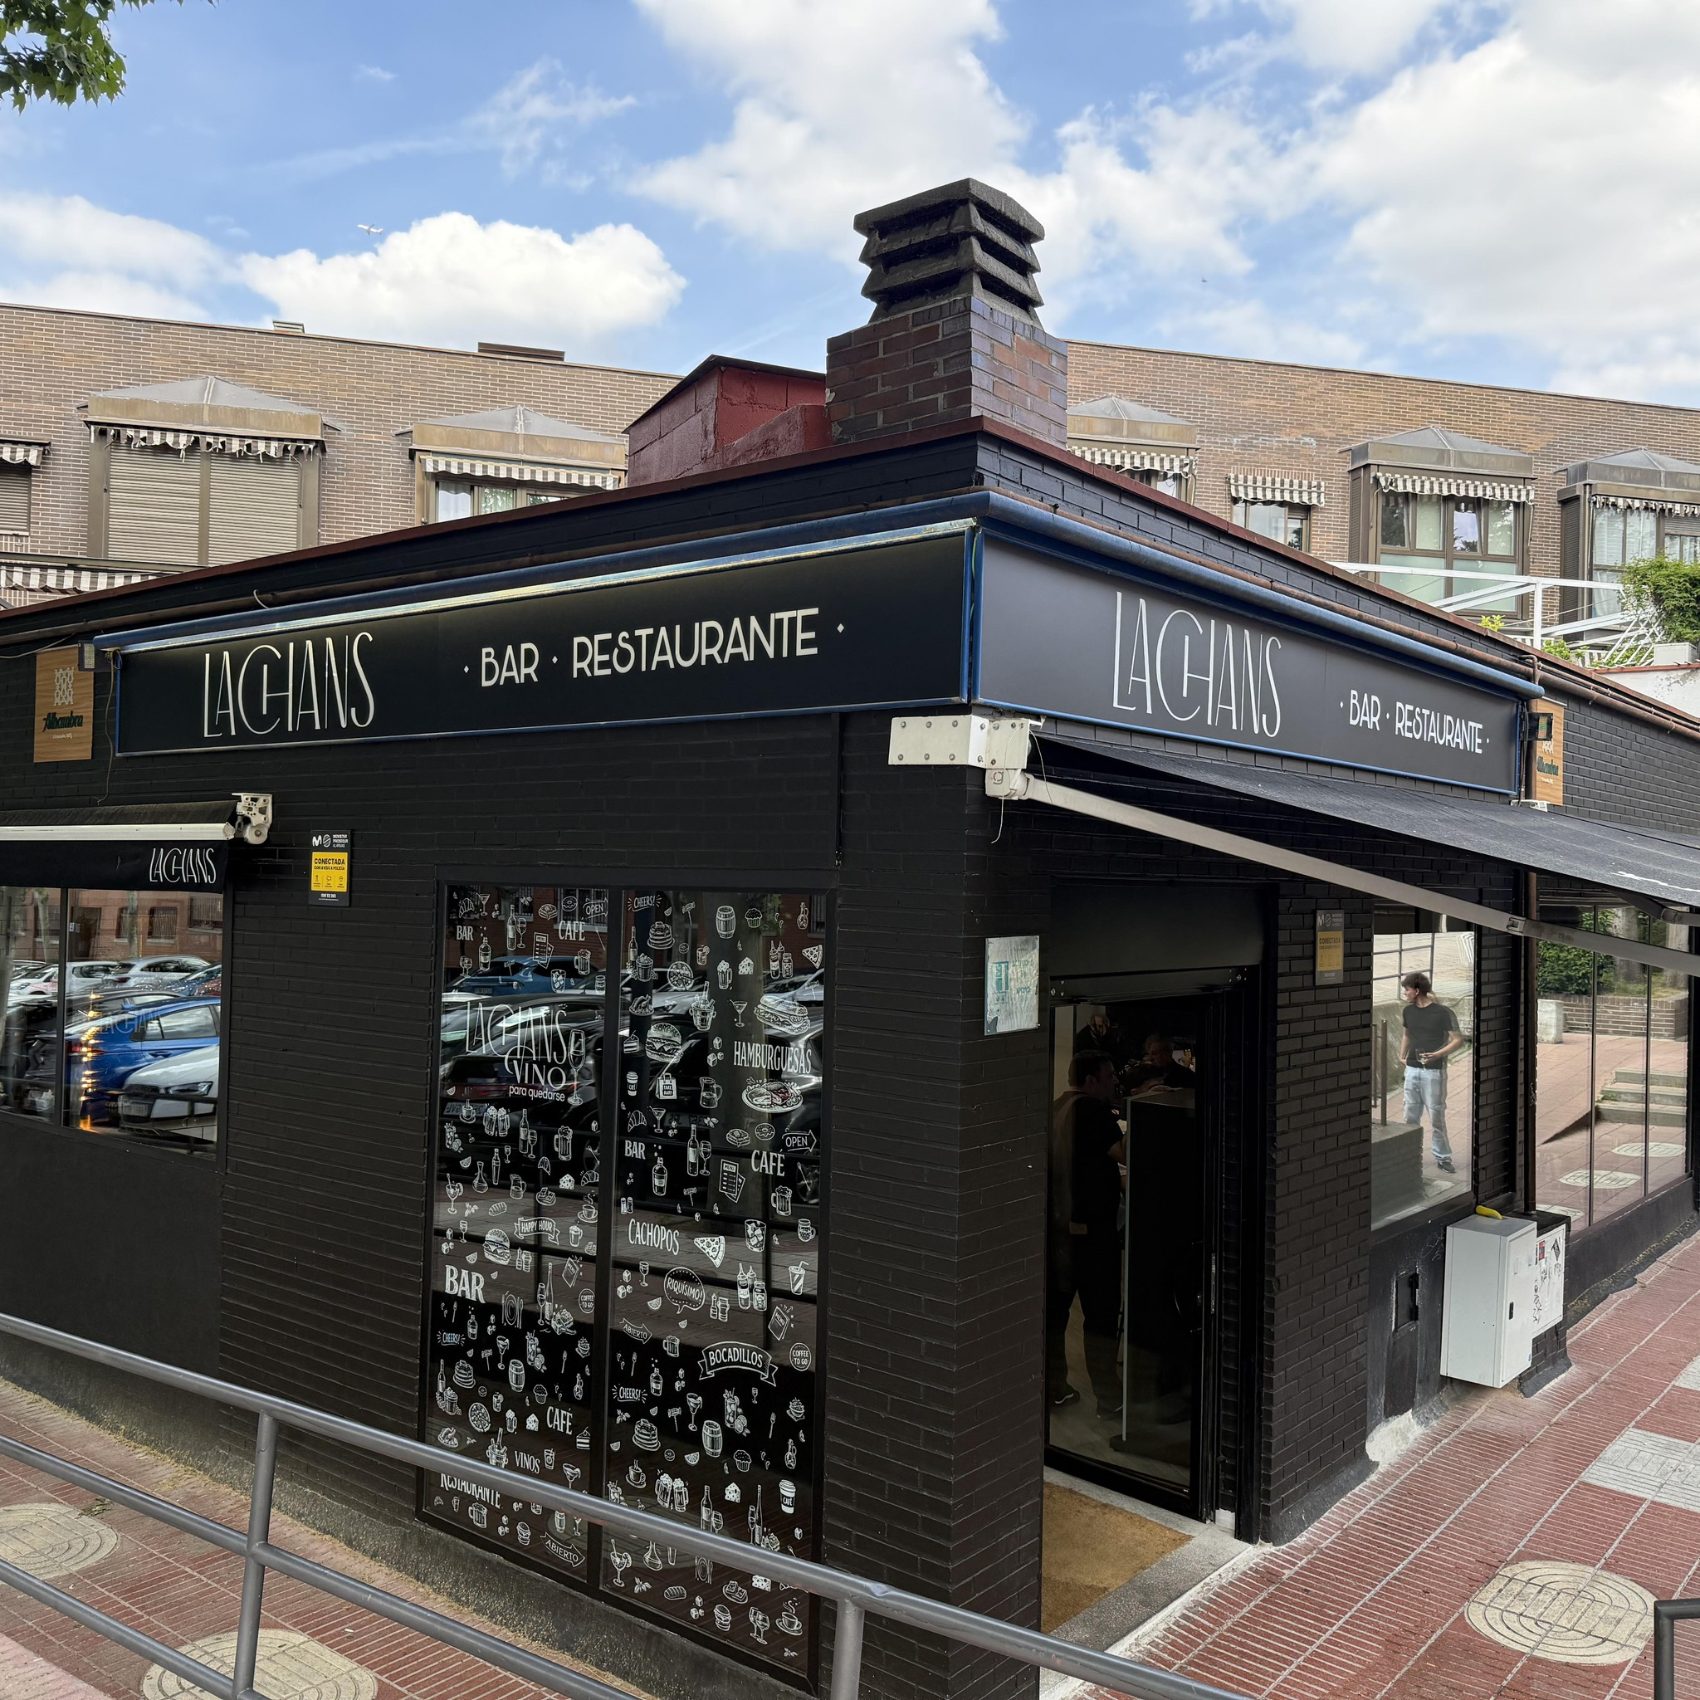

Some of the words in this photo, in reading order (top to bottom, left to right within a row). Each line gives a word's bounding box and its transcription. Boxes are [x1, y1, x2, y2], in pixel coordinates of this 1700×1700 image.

[481, 642, 539, 688] BAR
[572, 607, 819, 679] RESTAURANTE
[1112, 591, 1282, 738] LACHANS
[203, 632, 375, 738] LACHANS
[1349, 689, 1381, 731] BAR
[1395, 701, 1483, 754] RESTAURANTE
[149, 847, 217, 884] LACHANS
[585, 903, 604, 915] OPEN
[633, 896, 656, 908] CHEERS!
[456, 925, 474, 941] BAR
[558, 918, 586, 941] CAFÉ
[465, 1001, 567, 1065] LACHANS
[733, 1041, 812, 1074] HAMBURGUESAS
[511, 1058, 566, 1090] VINO
[508, 1085, 527, 1098] para
[528, 1087, 566, 1102] quedarse
[624, 1140, 646, 1160] BAR
[785, 1136, 808, 1148] OPEN
[751, 1149, 786, 1177] CAFÉ
[521, 1221, 538, 1233] HAPPY
[538, 1220, 554, 1232] HOUR
[628, 1218, 680, 1256] CACHOPOS
[444, 1264, 486, 1304] BAR
[666, 1279, 704, 1301] RIQUÍSIMO!
[442, 1331, 461, 1344] CHEERS!
[623, 1323, 648, 1340] ABIERTO
[708, 1347, 764, 1368] BOCADILLOS
[792, 1350, 809, 1358] COFFEE
[794, 1357, 801, 1365] TO
[801, 1357, 808, 1365] GO
[618, 1387, 641, 1400] CHEERS!
[546, 1407, 573, 1435] CAFÉ
[514, 1450, 541, 1474] VINOS
[545, 1538, 580, 1563] ABIERTO
